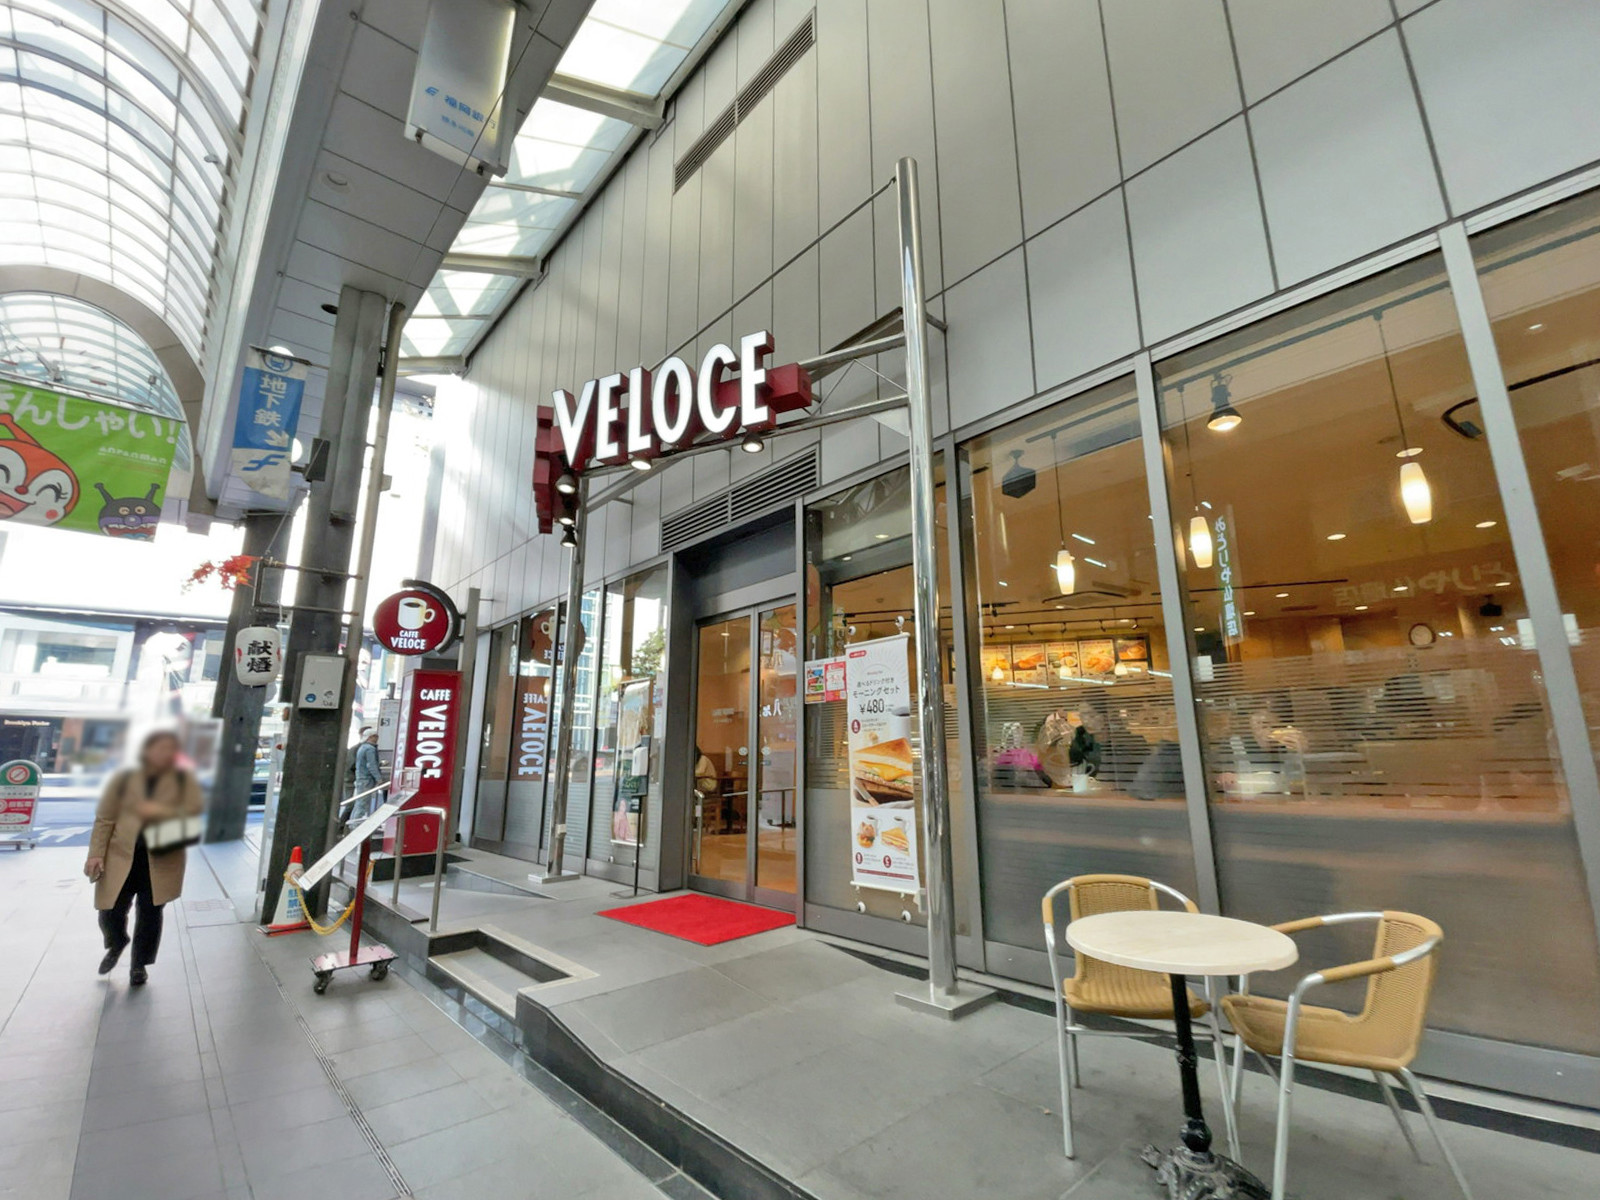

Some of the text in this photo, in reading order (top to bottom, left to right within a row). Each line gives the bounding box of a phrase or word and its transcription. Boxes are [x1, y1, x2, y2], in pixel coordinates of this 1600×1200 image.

[253, 374, 288, 428] 地下鉄
[552, 330, 772, 469] VELOCE
[399, 629, 419, 638] CAFFE
[390, 637, 427, 650] VELOCE
[420, 688, 452, 702] CAFFE
[853, 685, 900, 699] モーニングセット
[860, 698, 885, 715] ¥480
[414, 703, 449, 779] VELOCE
